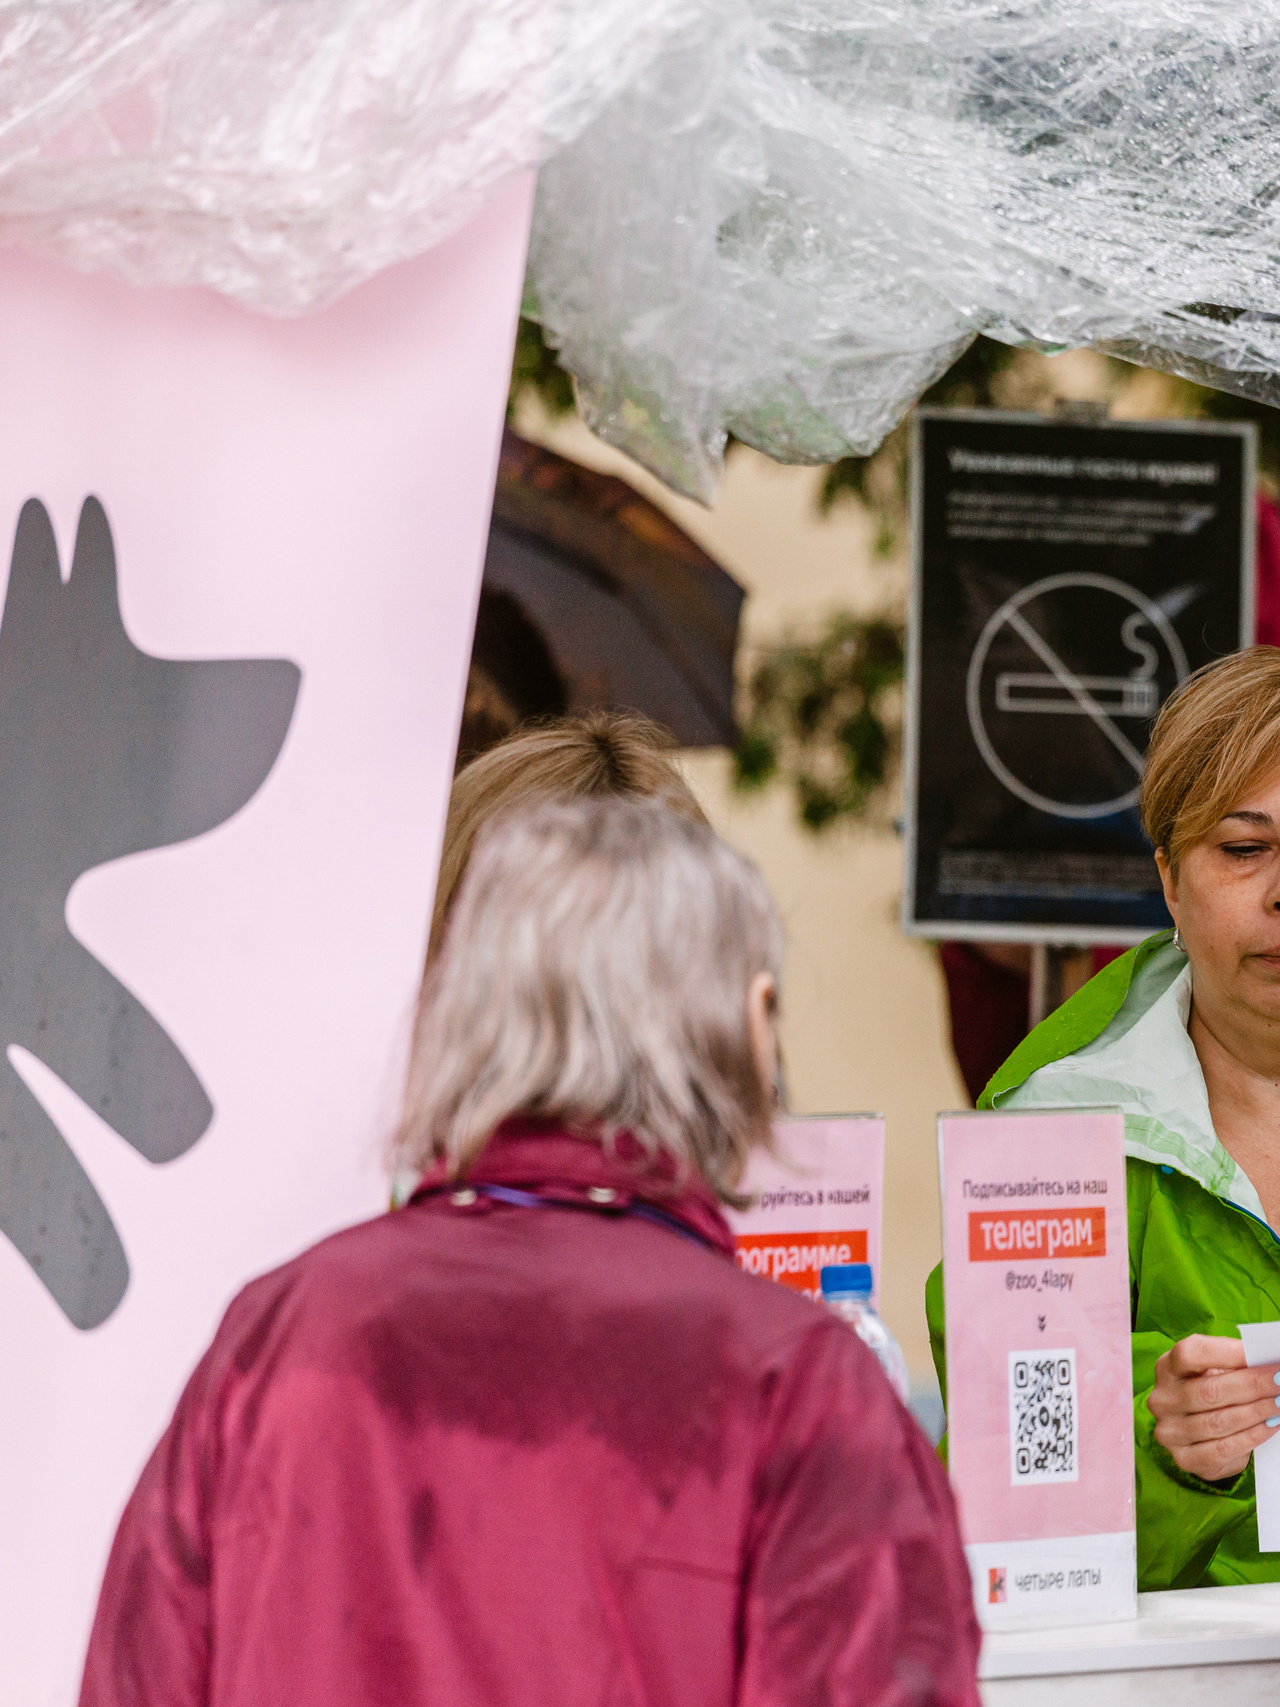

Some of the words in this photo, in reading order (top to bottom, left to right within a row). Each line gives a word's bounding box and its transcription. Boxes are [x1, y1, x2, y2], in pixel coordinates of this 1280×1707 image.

[827, 1184, 871, 1205] нашей
[962, 1177, 1064, 1201] Подписывайтесь
[1067, 1180, 1081, 1195] на
[1083, 1180, 1108, 1195] наш
[980, 1217, 1094, 1258] телеграм
[735, 1243, 852, 1283] рограмме
[1005, 1269, 1074, 1293] @zoo_4lapy
